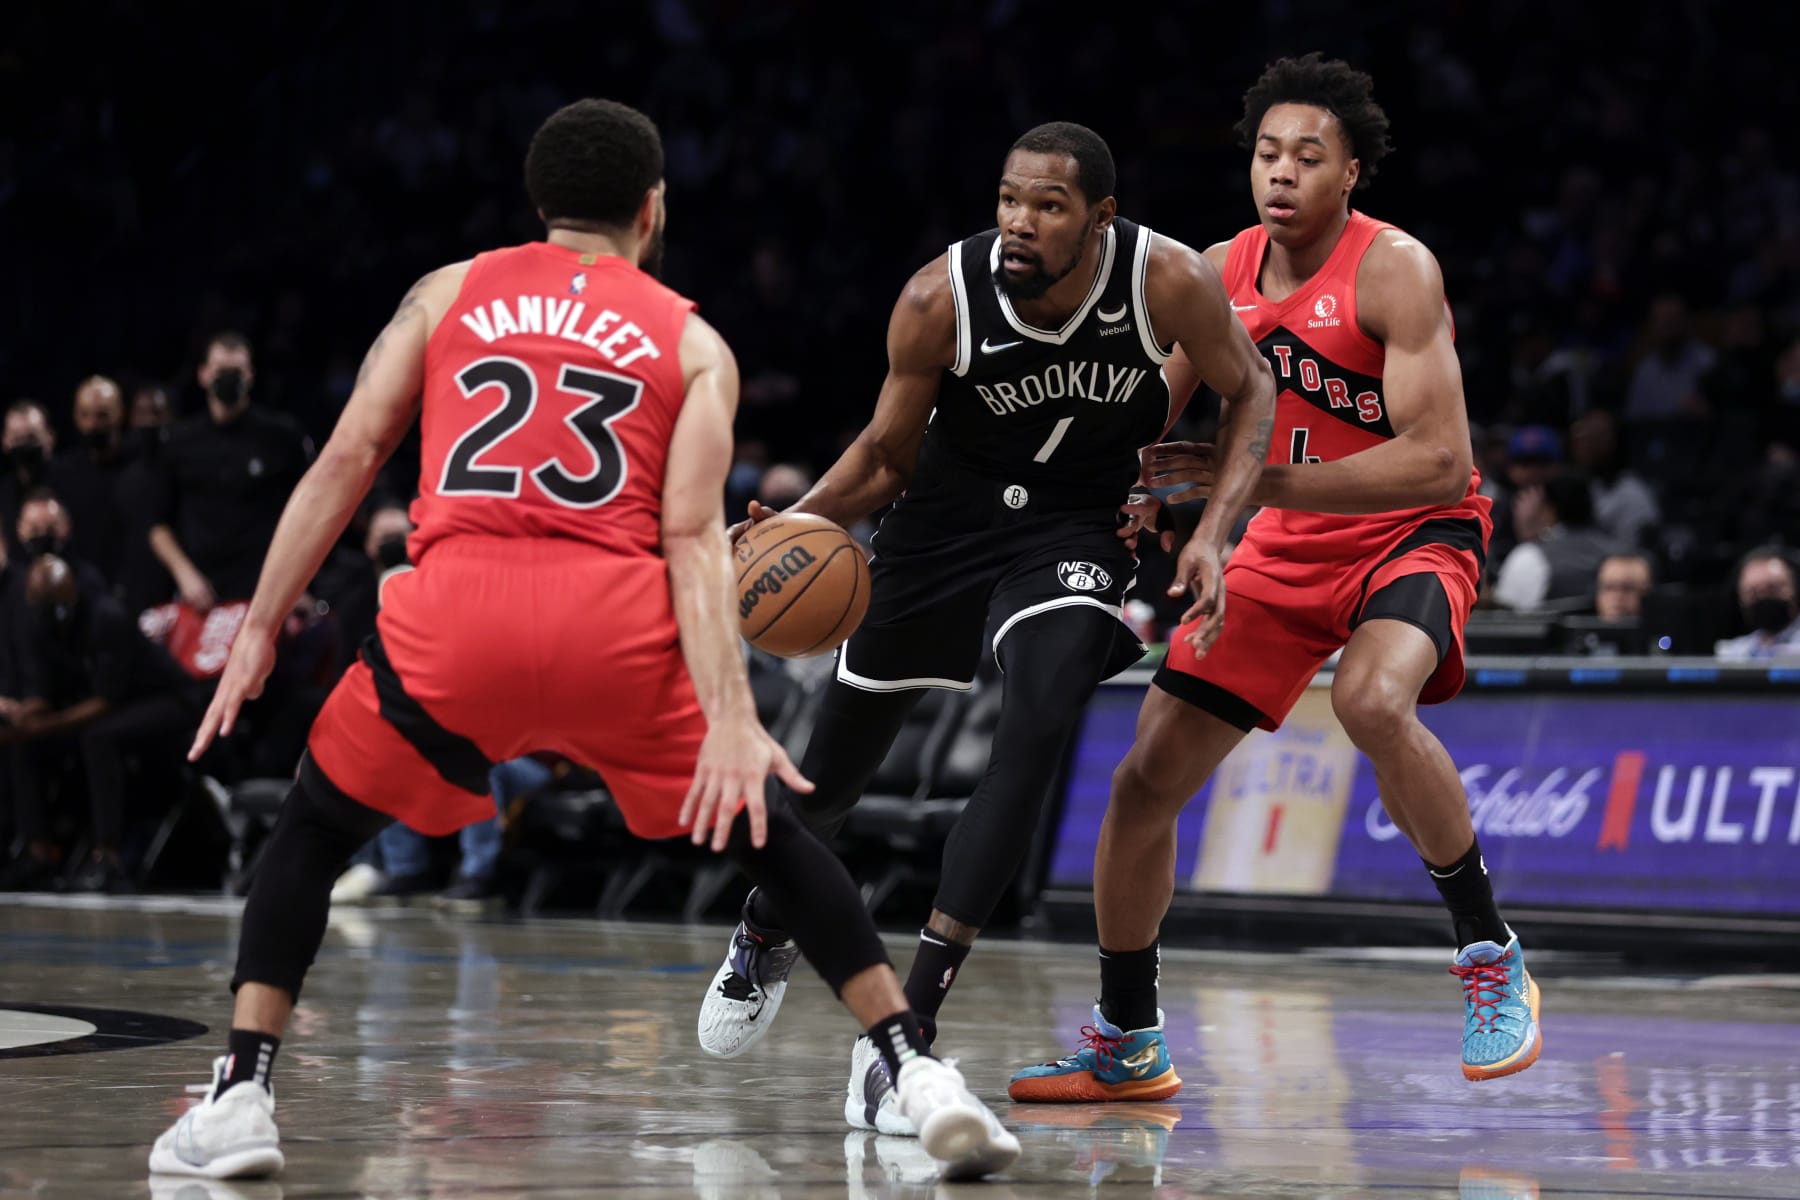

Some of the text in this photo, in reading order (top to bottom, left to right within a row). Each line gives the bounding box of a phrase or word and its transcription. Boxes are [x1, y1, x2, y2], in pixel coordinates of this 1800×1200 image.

[460, 296, 661, 368] VANVLEET
[1100, 324, 1131, 337] Webull
[1307, 317, 1341, 329] Sun Life
[975, 361, 1147, 415] BROOKLYN
[1263, 345, 1382, 423] TORS
[436, 356, 644, 509] 23
[1033, 416, 1075, 464] 1
[1061, 561, 1110, 585] NETS
[1651, 765, 1800, 844] ULT
